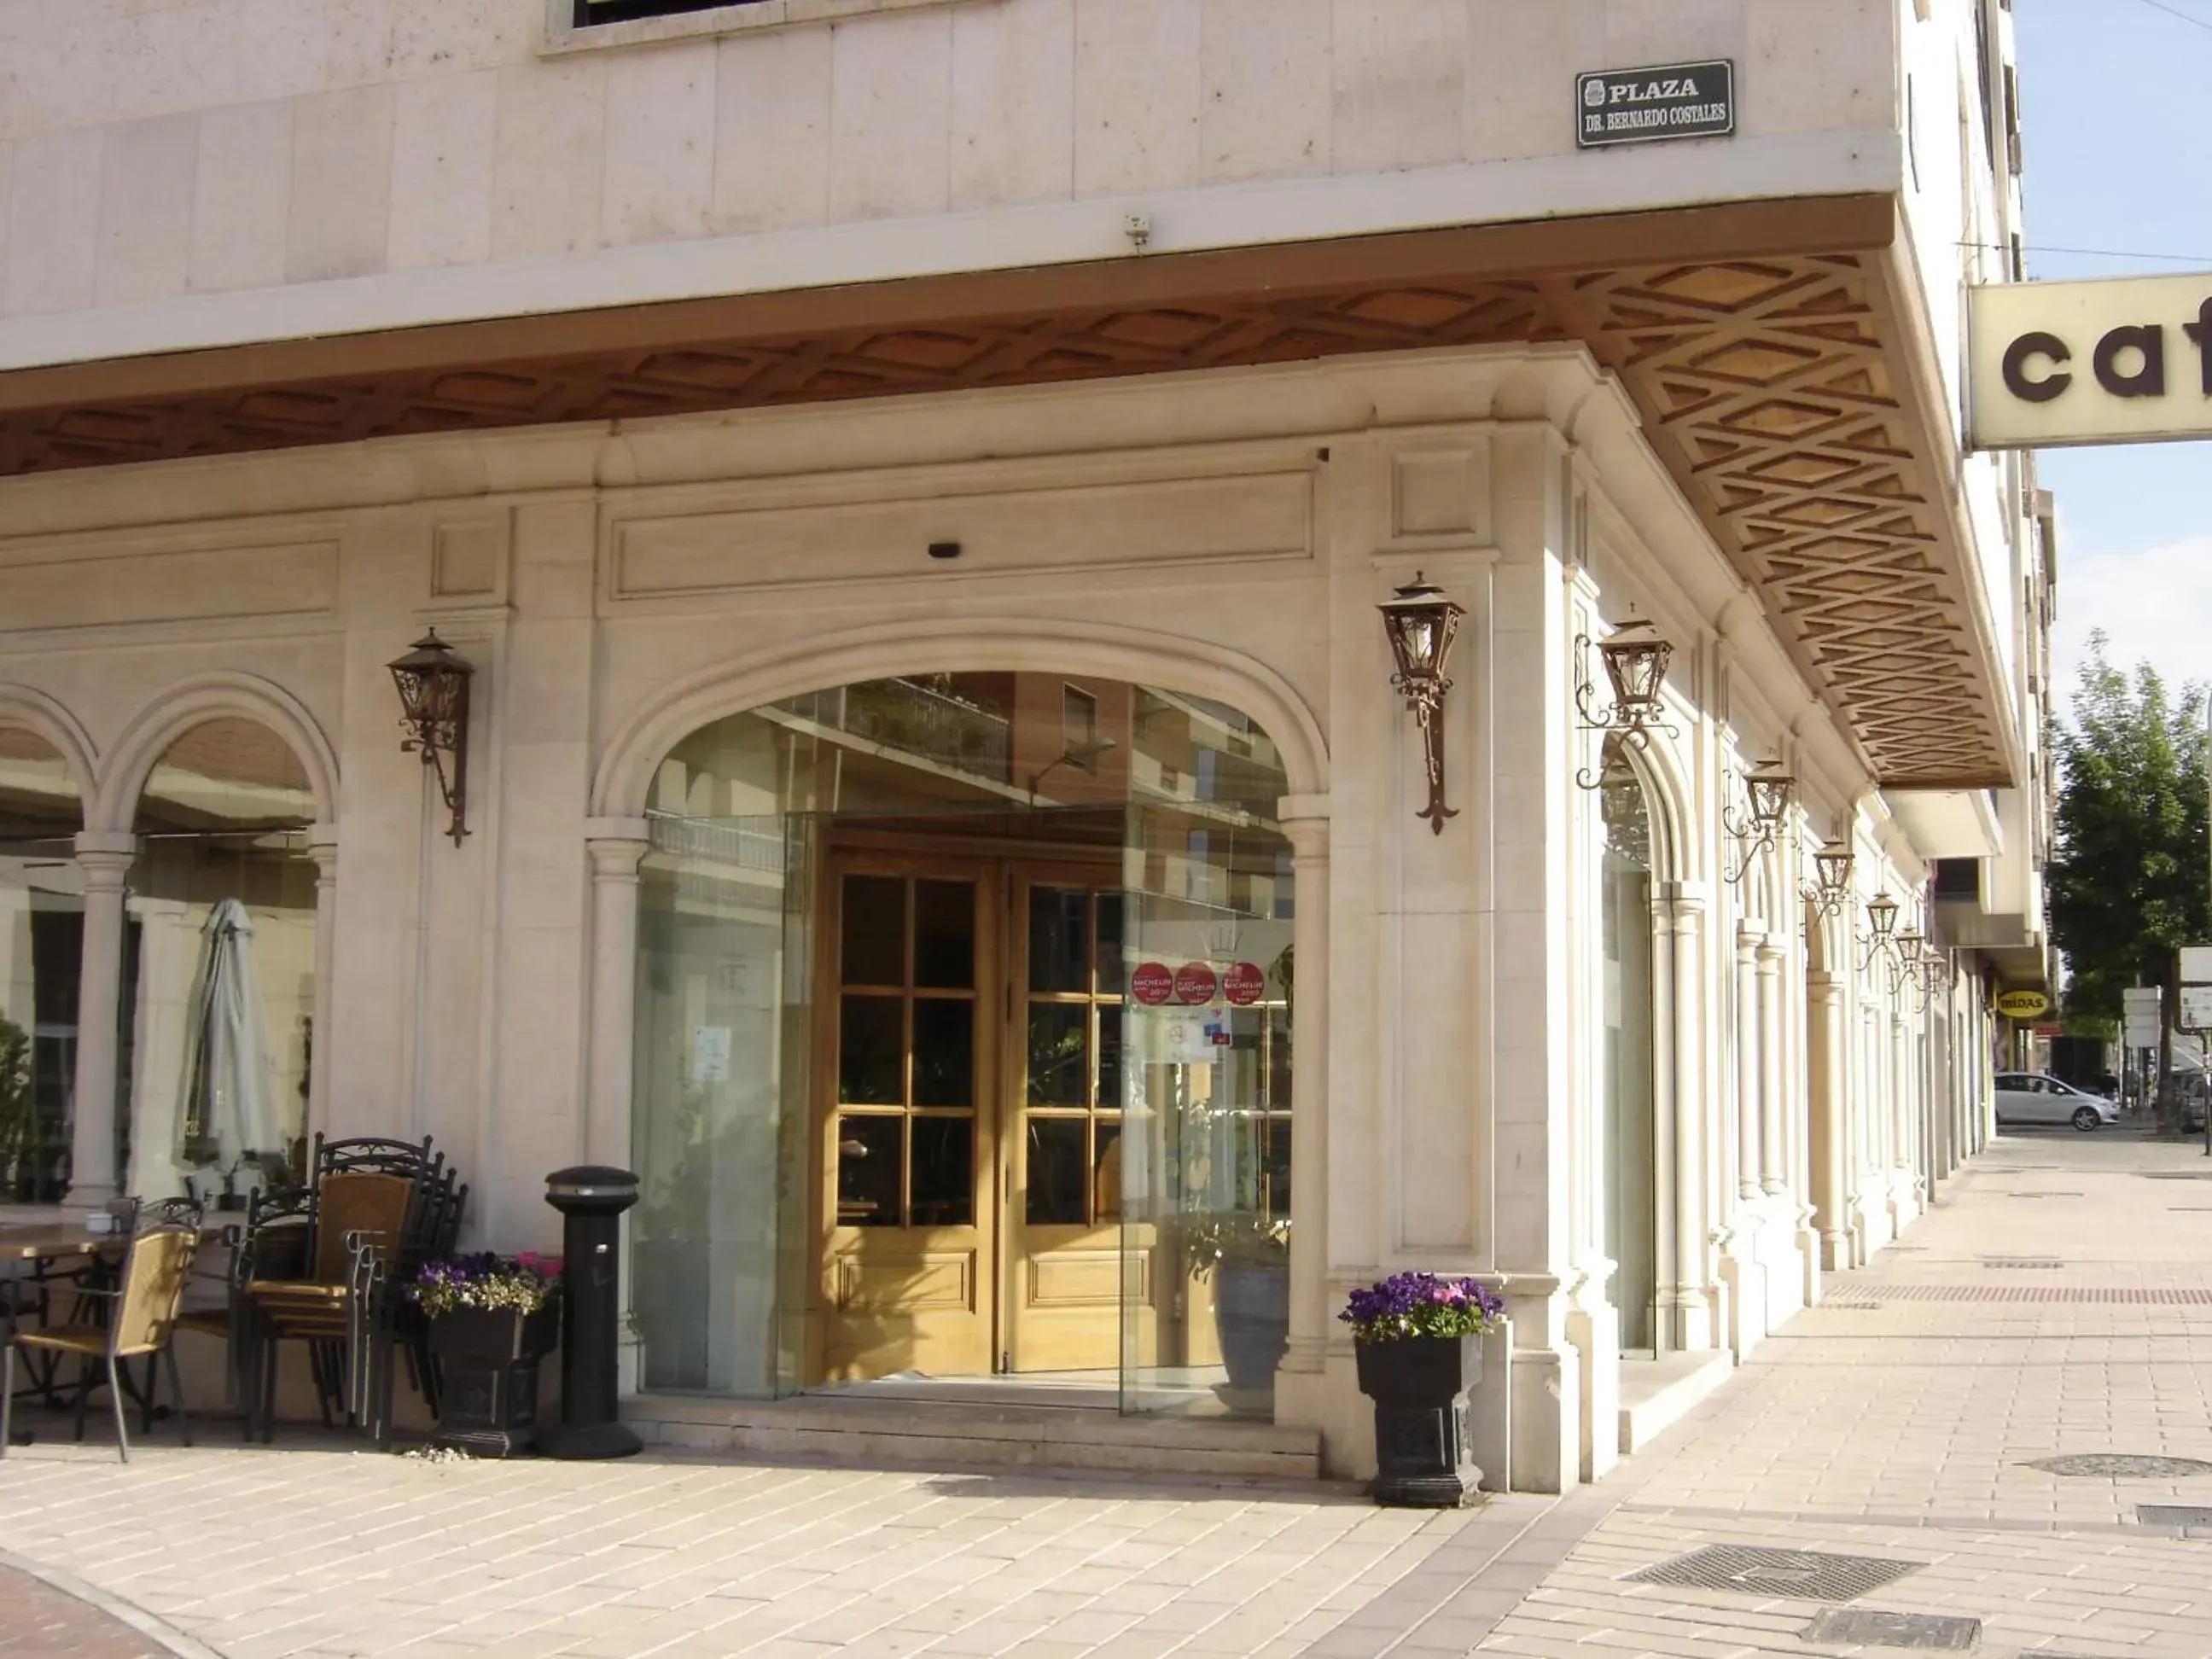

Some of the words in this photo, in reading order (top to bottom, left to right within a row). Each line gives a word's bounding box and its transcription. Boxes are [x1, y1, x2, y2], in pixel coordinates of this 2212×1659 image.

[1609, 79, 1699, 103] PLAZA
[1585, 114, 1604, 132] DR.
[1607, 108, 1668, 131] BERNARDO
[1670, 102, 1726, 125] COSTALES
